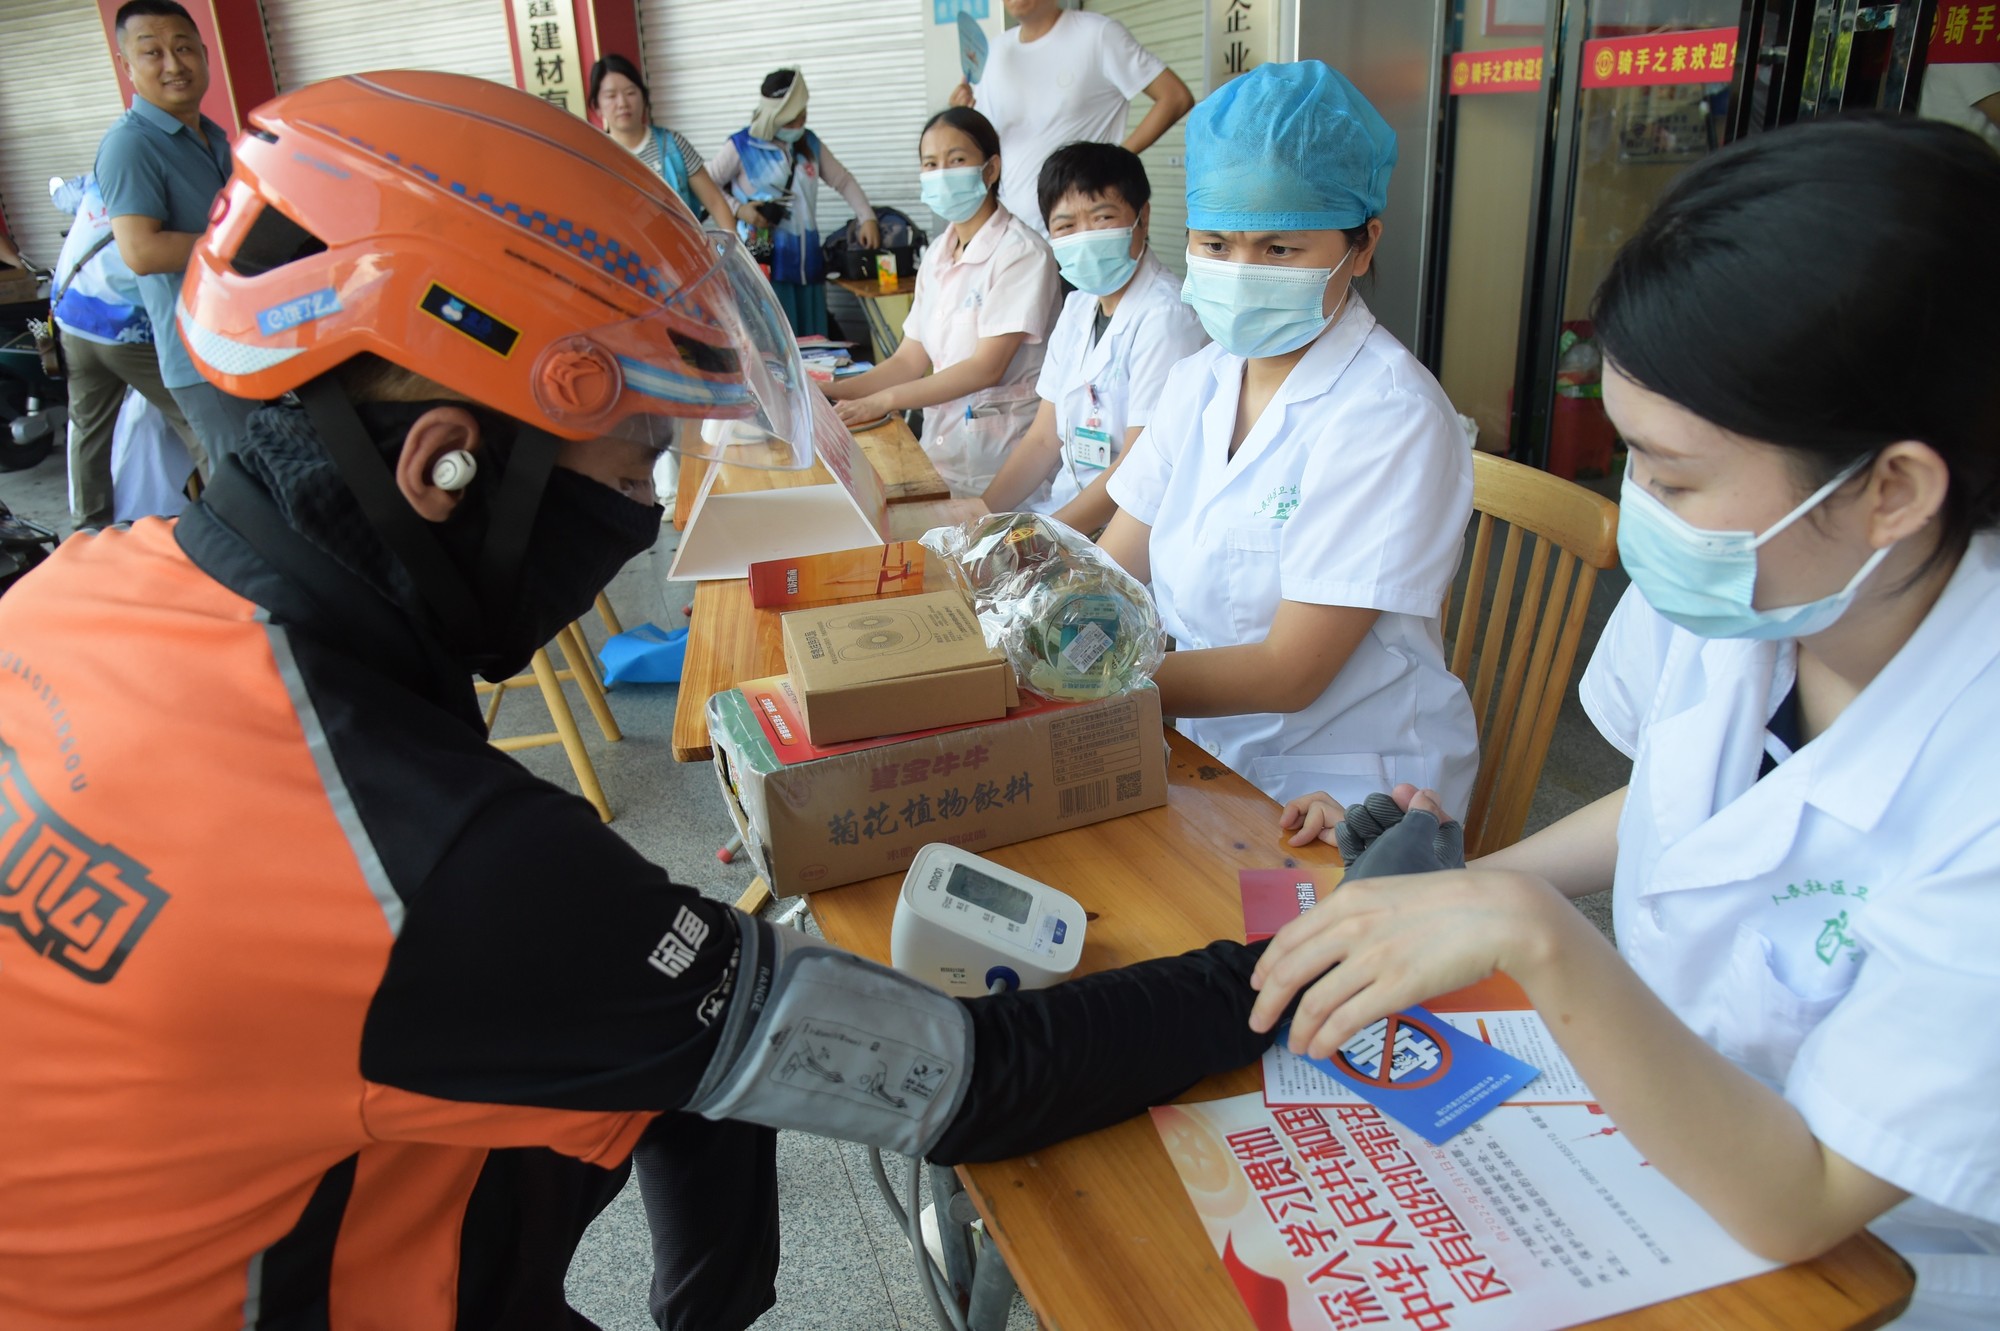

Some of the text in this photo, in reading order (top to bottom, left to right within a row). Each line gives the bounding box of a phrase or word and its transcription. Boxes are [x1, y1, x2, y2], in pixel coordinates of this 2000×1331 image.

[1943, 4, 2000, 45] 骑手
[1253, 485, 1301, 517] 人民社区卫生
[928, 868, 945, 892] OMRON
[1296, 882, 1316, 914] 访指南
[647, 904, 709, 979] 闲鱼
[751, 966, 771, 1013] RANGE
[1273, 1107, 1455, 1331] 中华人民共和国
[1337, 1105, 1512, 1304] 反有组织犯罪法
[1226, 1127, 1389, 1331] 深入学习贯彻
